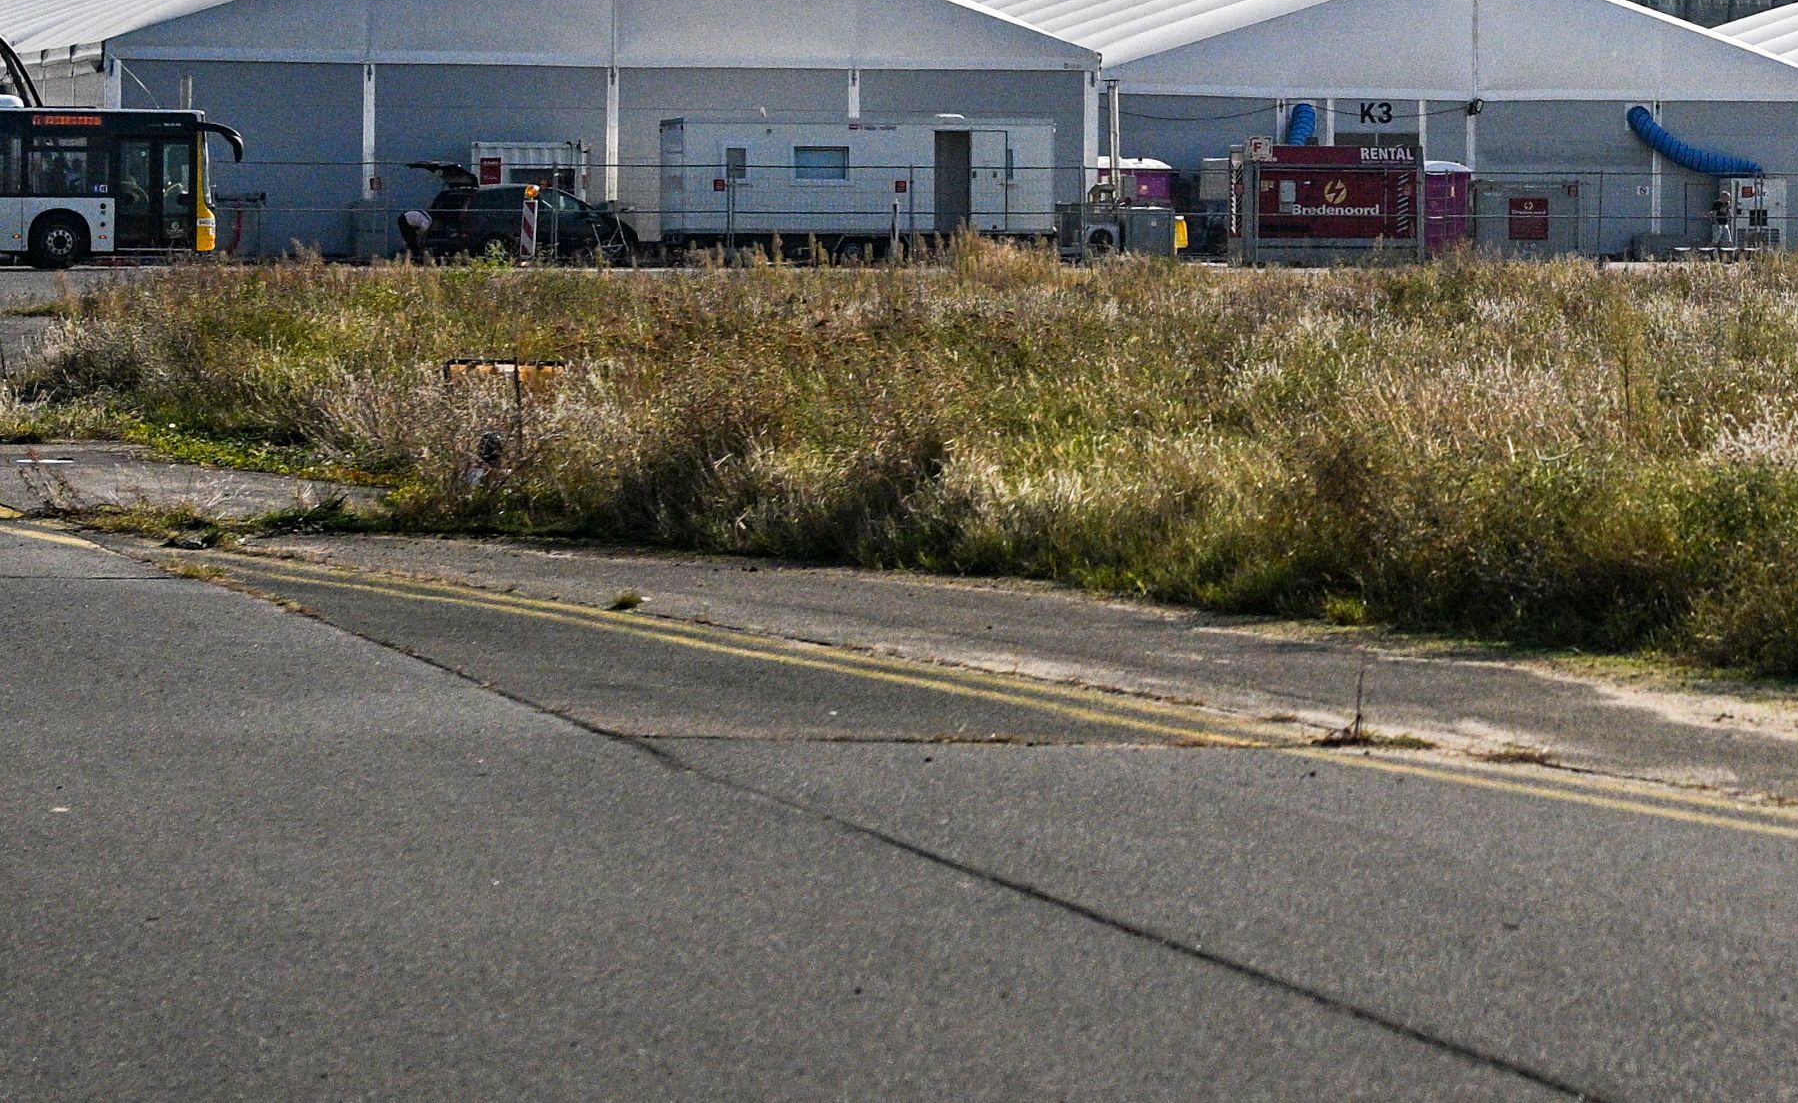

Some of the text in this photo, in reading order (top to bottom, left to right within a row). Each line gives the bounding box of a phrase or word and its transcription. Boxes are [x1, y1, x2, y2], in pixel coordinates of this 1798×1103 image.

[1360, 102, 1393, 124] K3
[1360, 147, 1415, 160] RENTAL
[1292, 204, 1380, 216] Bredenoord
